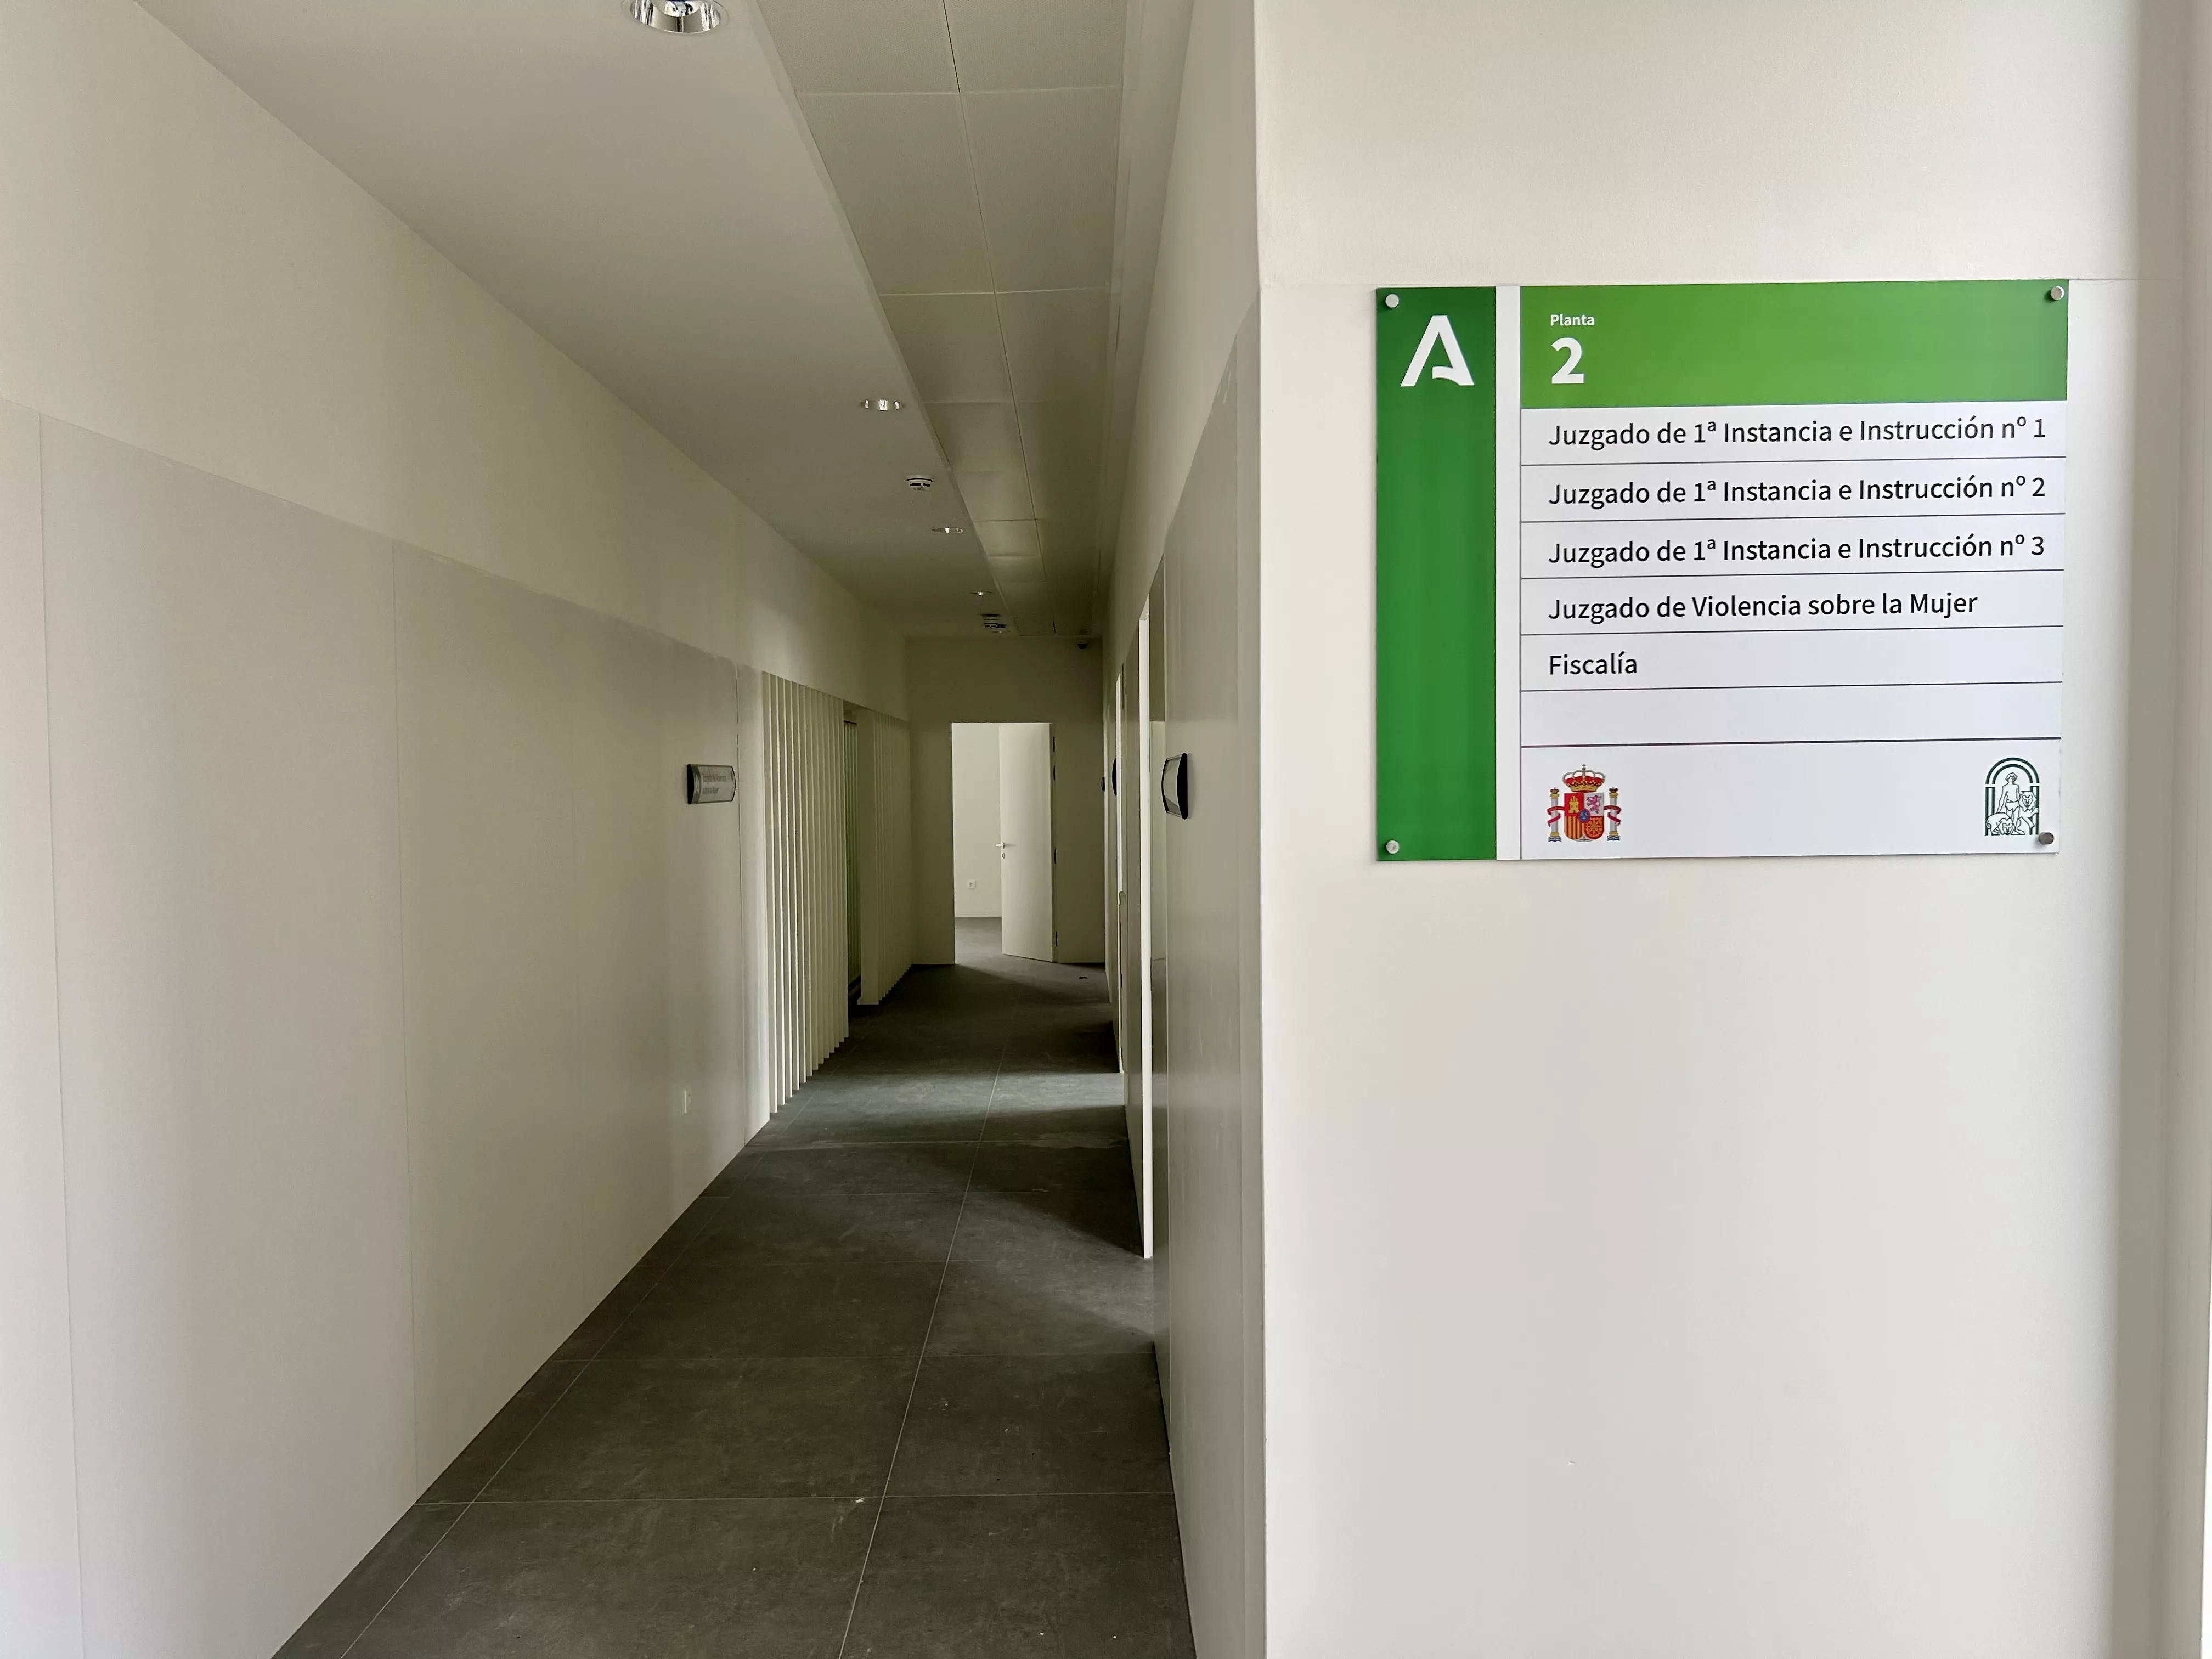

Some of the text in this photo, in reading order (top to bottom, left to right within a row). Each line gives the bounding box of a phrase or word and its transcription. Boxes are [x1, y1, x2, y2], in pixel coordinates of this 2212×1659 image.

[1550, 313, 1595, 326] Planta
[1551, 337, 1585, 385] 2
[1548, 415, 2046, 452] Juzgado de 1ª Instancia e Instrucción nº 1
[1548, 473, 2046, 510] Juzgado de 1ª Instancia e Instrucción nº 2
[1548, 532, 2045, 569] Juzgado de 1ª Instancia e Instrucción nº 3
[1547, 591, 1979, 625] Juzgado de Violencia sobre la Mujer
[1548, 650, 1638, 676] Fiscalía
